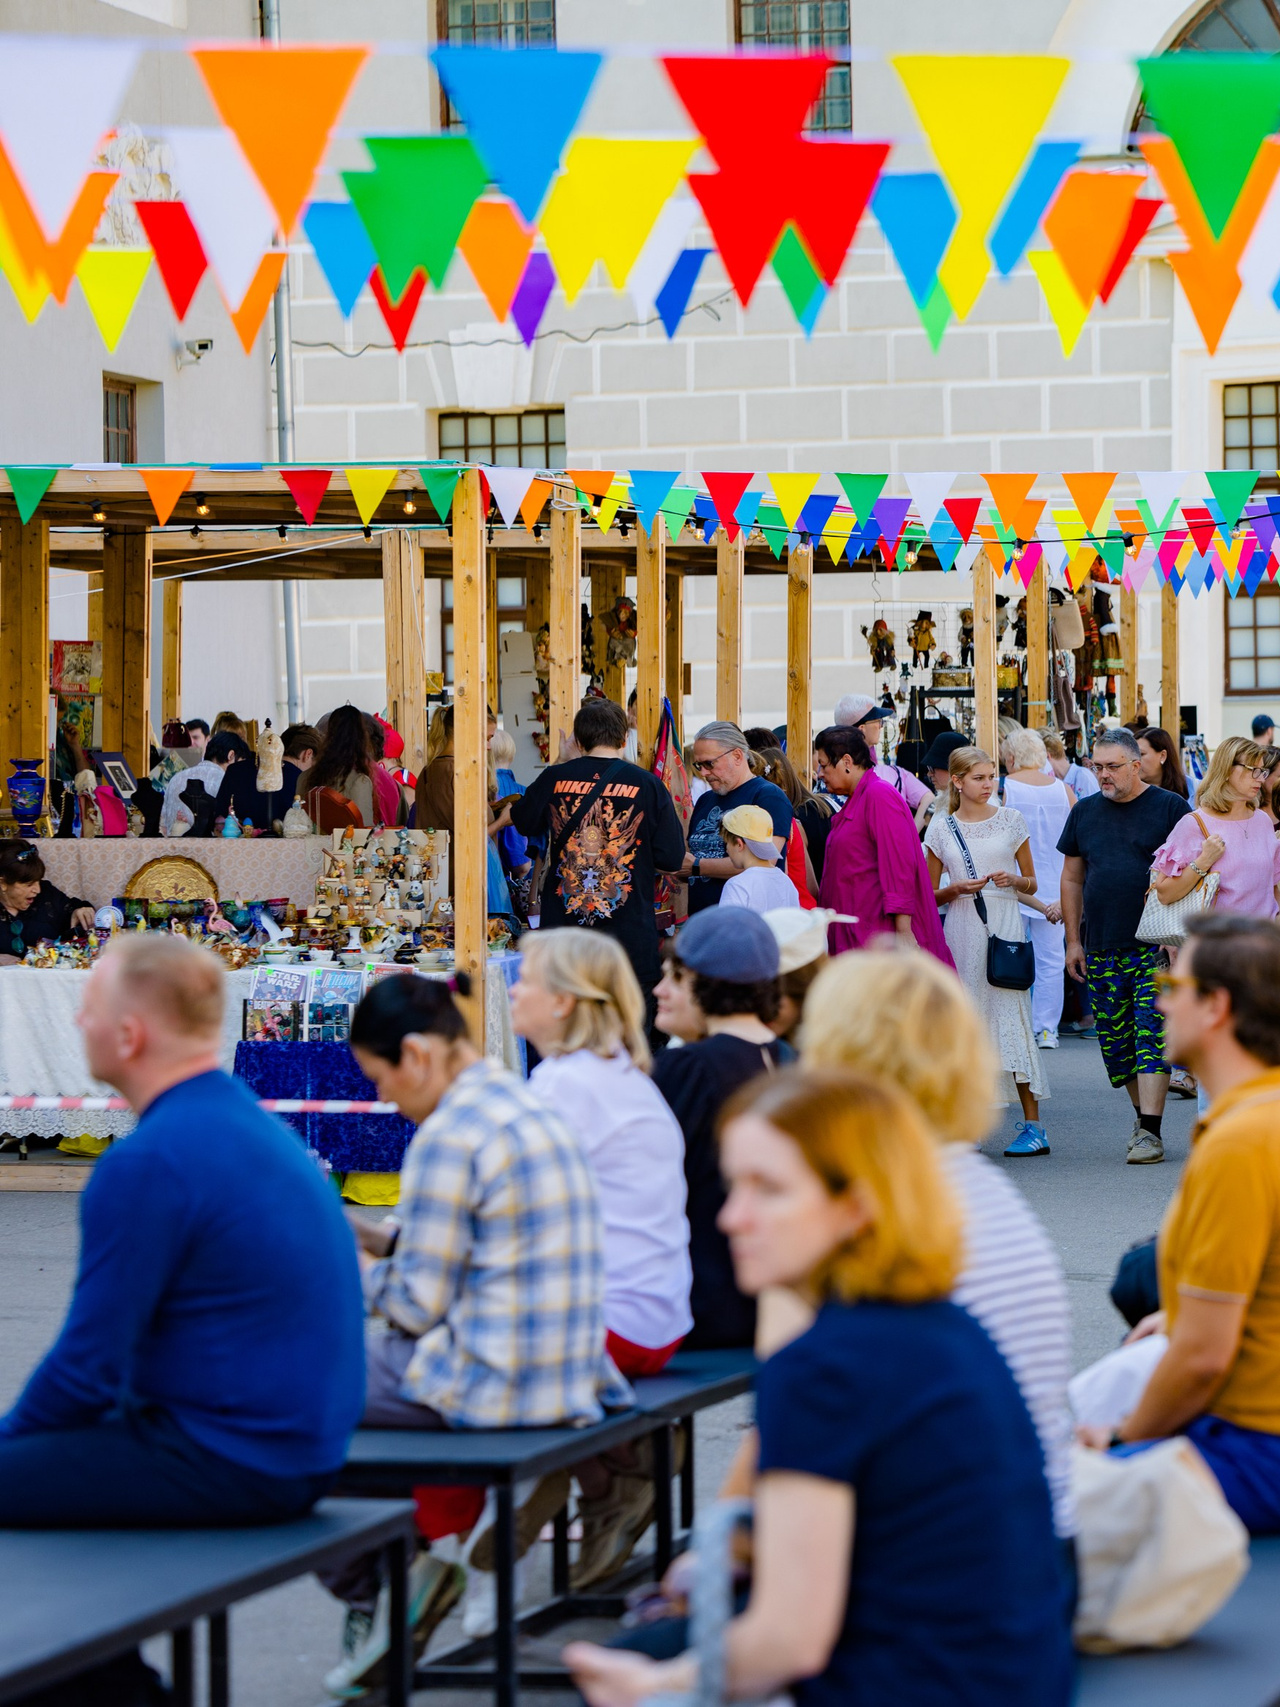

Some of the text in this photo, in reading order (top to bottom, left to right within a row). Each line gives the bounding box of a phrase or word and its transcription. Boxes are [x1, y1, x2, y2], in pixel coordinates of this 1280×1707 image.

[553, 780, 640, 799] NIKILINI
[267, 977, 301, 990] WARS
[271, 971, 301, 983] STAR
